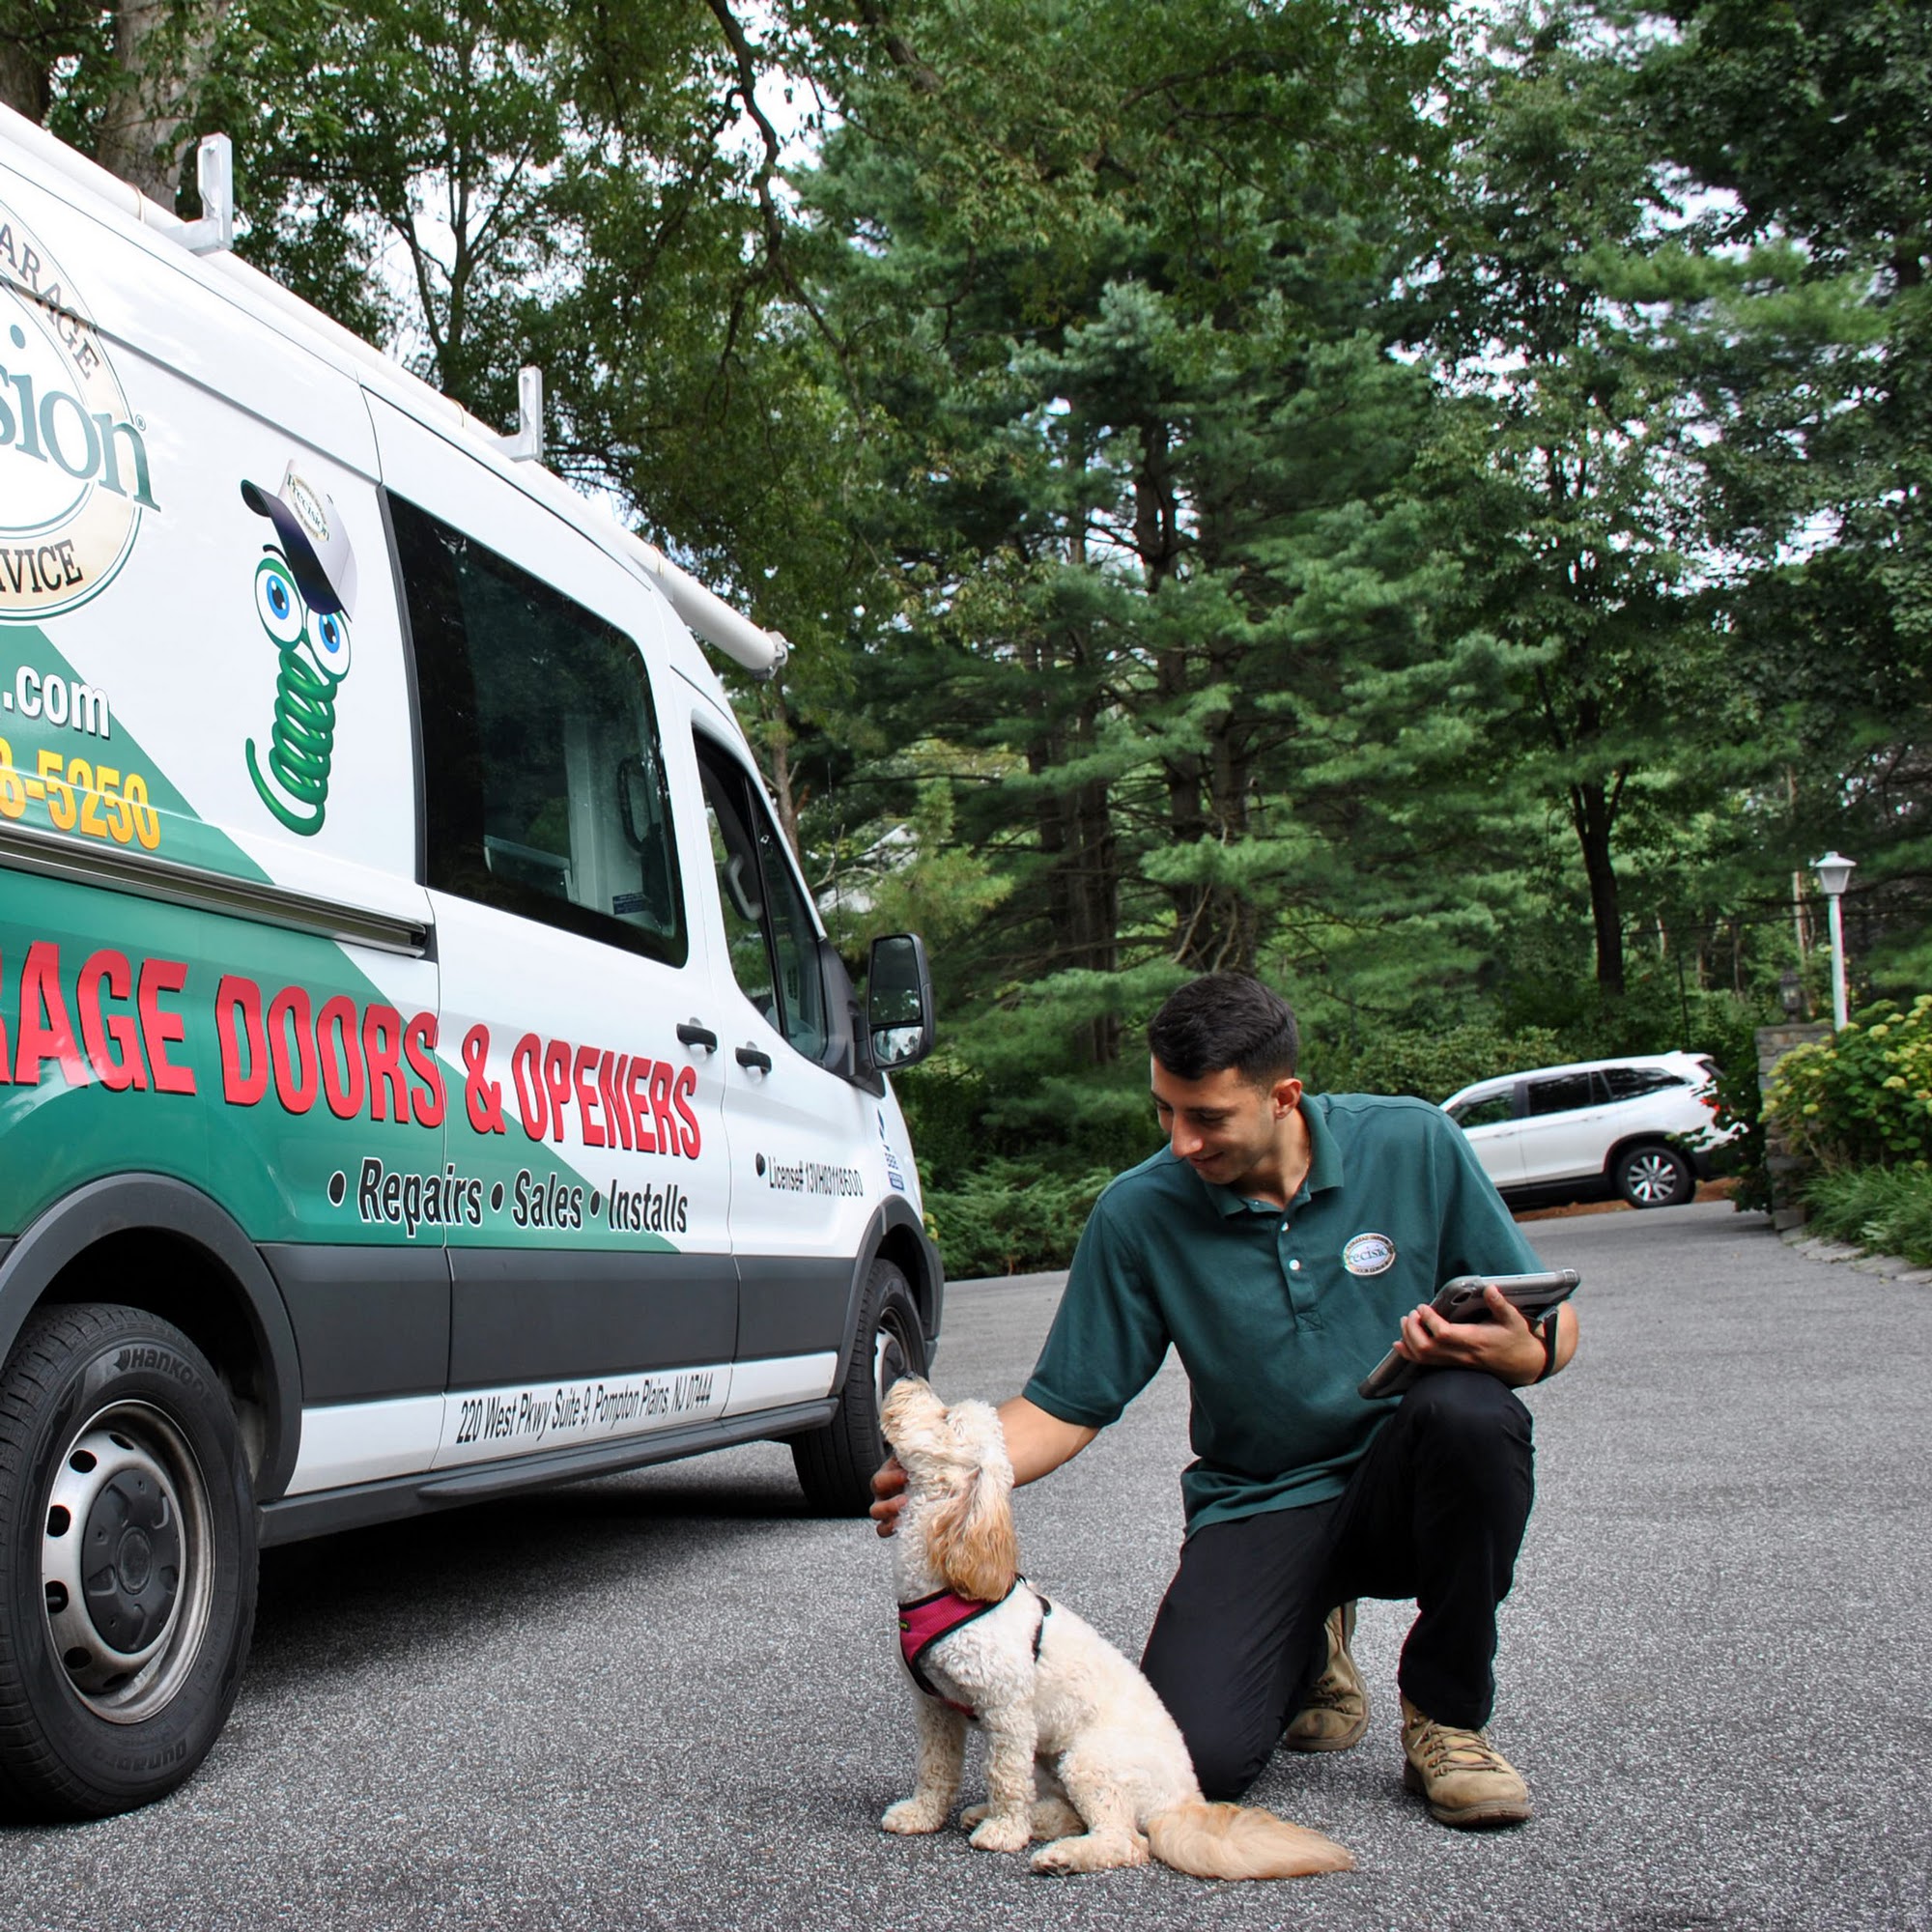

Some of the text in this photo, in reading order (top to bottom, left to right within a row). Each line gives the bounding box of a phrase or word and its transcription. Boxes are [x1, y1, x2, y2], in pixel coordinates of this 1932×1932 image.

[0, 538, 84, 594] VICE
[3, 665, 112, 740] .com
[0, 940, 701, 1160] AGE DOORS & OPENERS
[358, 1157, 689, 1238] Repairs Sales Installs
[768, 1155, 804, 1193] License#
[128, 1347, 211, 1406] Hankoo
[455, 1398, 483, 1444] 220
[483, 1396, 517, 1439] West
[516, 1392, 552, 1441] Pkwy
[552, 1387, 581, 1430] Suite
[592, 1383, 639, 1430] Pompton
[670, 1376, 687, 1412] NJ
[686, 1373, 713, 1410] 07444
